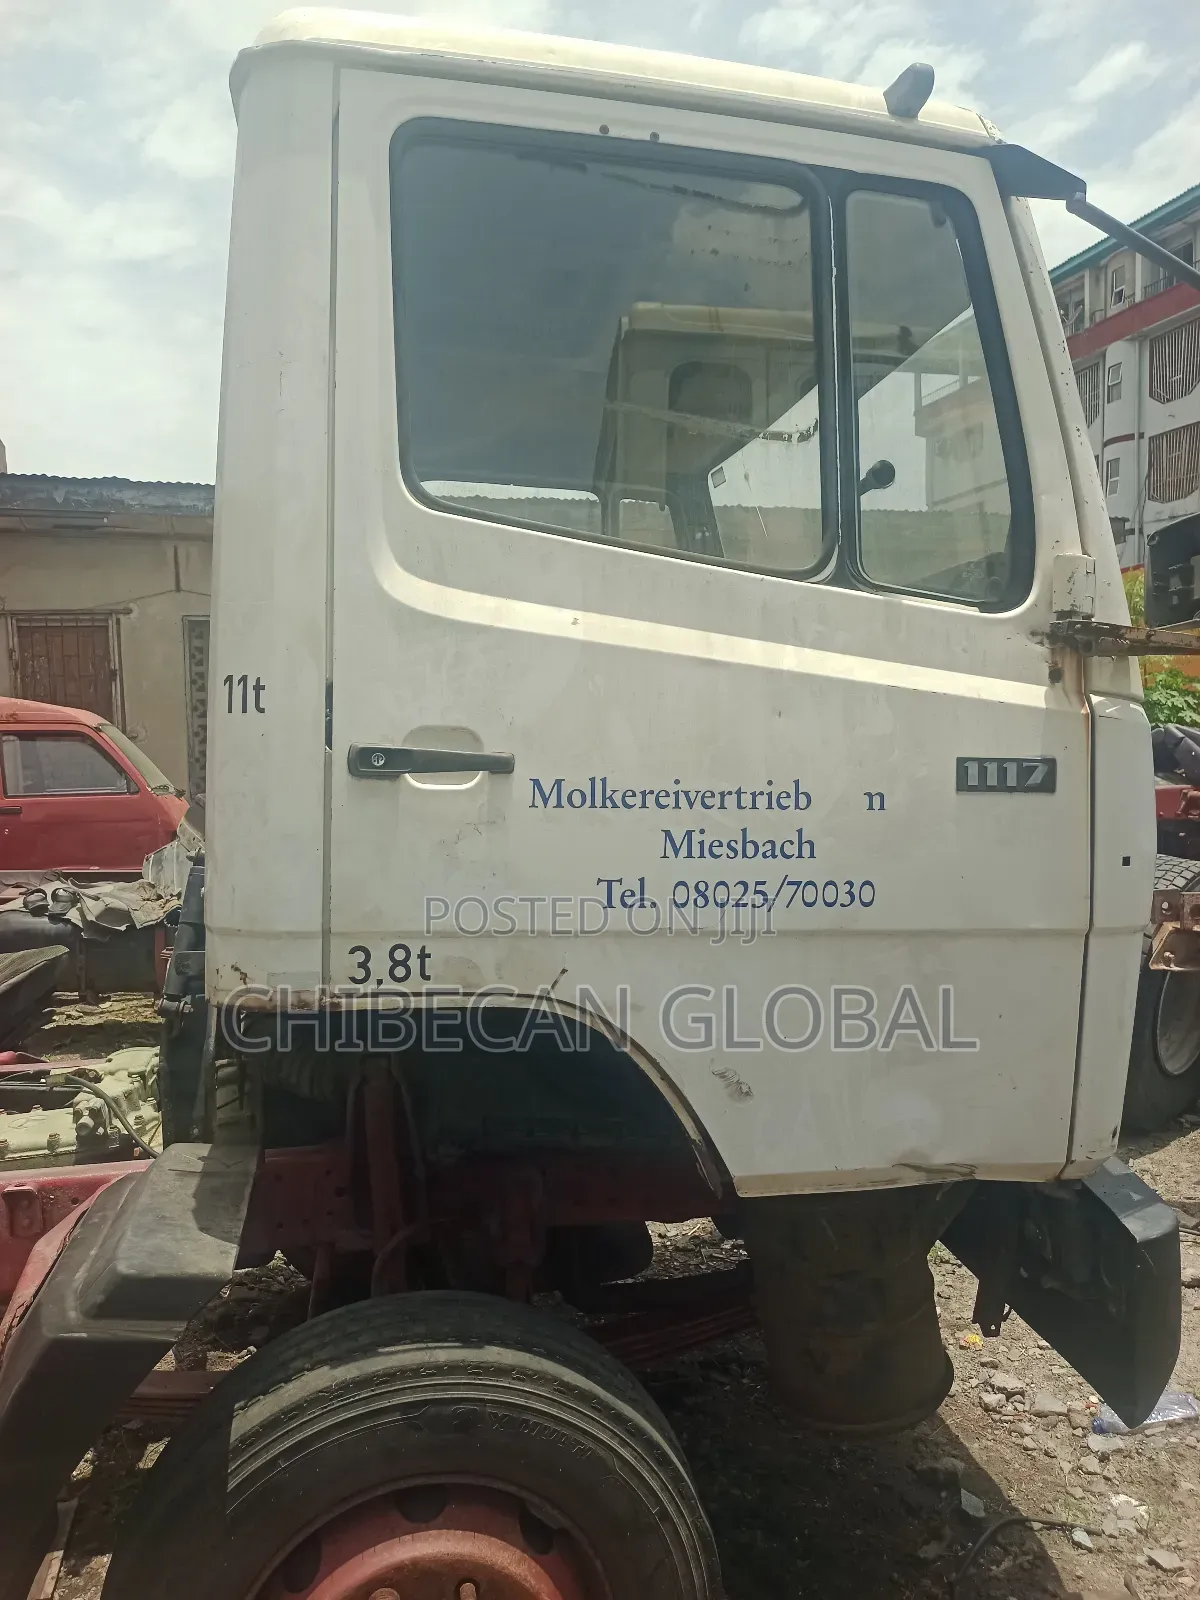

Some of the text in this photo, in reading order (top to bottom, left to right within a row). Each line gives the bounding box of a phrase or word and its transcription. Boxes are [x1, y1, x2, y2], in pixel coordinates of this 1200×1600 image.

[223, 674, 266, 714] 11t
[963, 760, 1049, 788] 1117
[529, 776, 812, 811] Molkereivertrieb
[659, 827, 817, 860] Miesbach
[596, 874, 875, 913] Tel. 08025/70030
